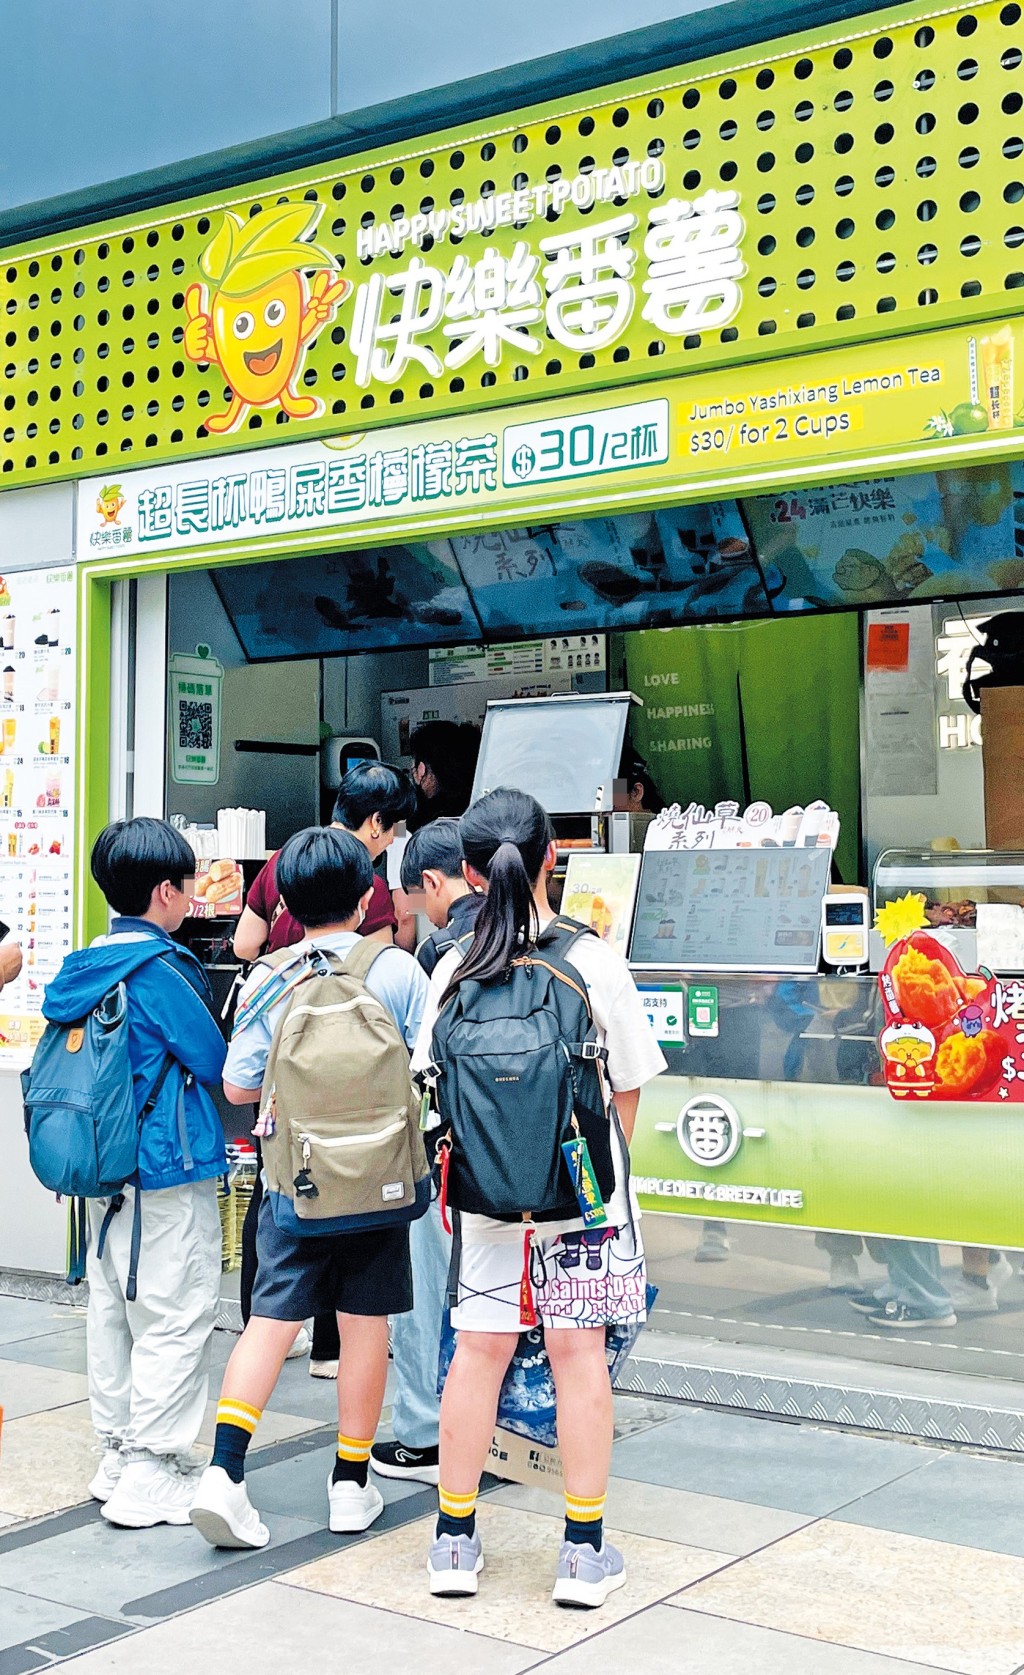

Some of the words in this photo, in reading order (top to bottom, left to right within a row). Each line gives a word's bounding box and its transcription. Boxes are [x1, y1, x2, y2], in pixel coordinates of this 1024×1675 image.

[356, 209, 447, 260] HAPPY
[450, 183, 550, 236] SWEET
[550, 157, 664, 212] POTATO
[350, 189, 747, 388] 快樂番薯
[689, 401, 746, 421] Jumbo
[749, 383, 839, 412] Yashixiang
[842, 372, 903, 397] Lemon
[907, 366, 941, 386] Tea
[690, 425, 735, 454] $30/
[739, 422, 770, 446] for
[775, 418, 788, 440] 2
[794, 412, 850, 438] Cups
[137, 433, 499, 543] 超長杯鴨屎香檸檬茶
[770, 499, 807, 523] $24
[644, 672, 680, 687] LOVE
[649, 736, 712, 752] SHARING
[656, 802, 741, 830] 燒仙草
[750, 810, 769, 823] 20
[668, 830, 715, 849] 系列
[686, 1107, 730, 1160] 番
[630, 1175, 674, 1196] IMPLE
[674, 1180, 705, 1199] DIET
[704, 1183, 718, 1201] &
[717, 1184, 768, 1206] BREEZY
[770, 1188, 804, 1209] LIFE
[612, 1274, 646, 1298] Day
